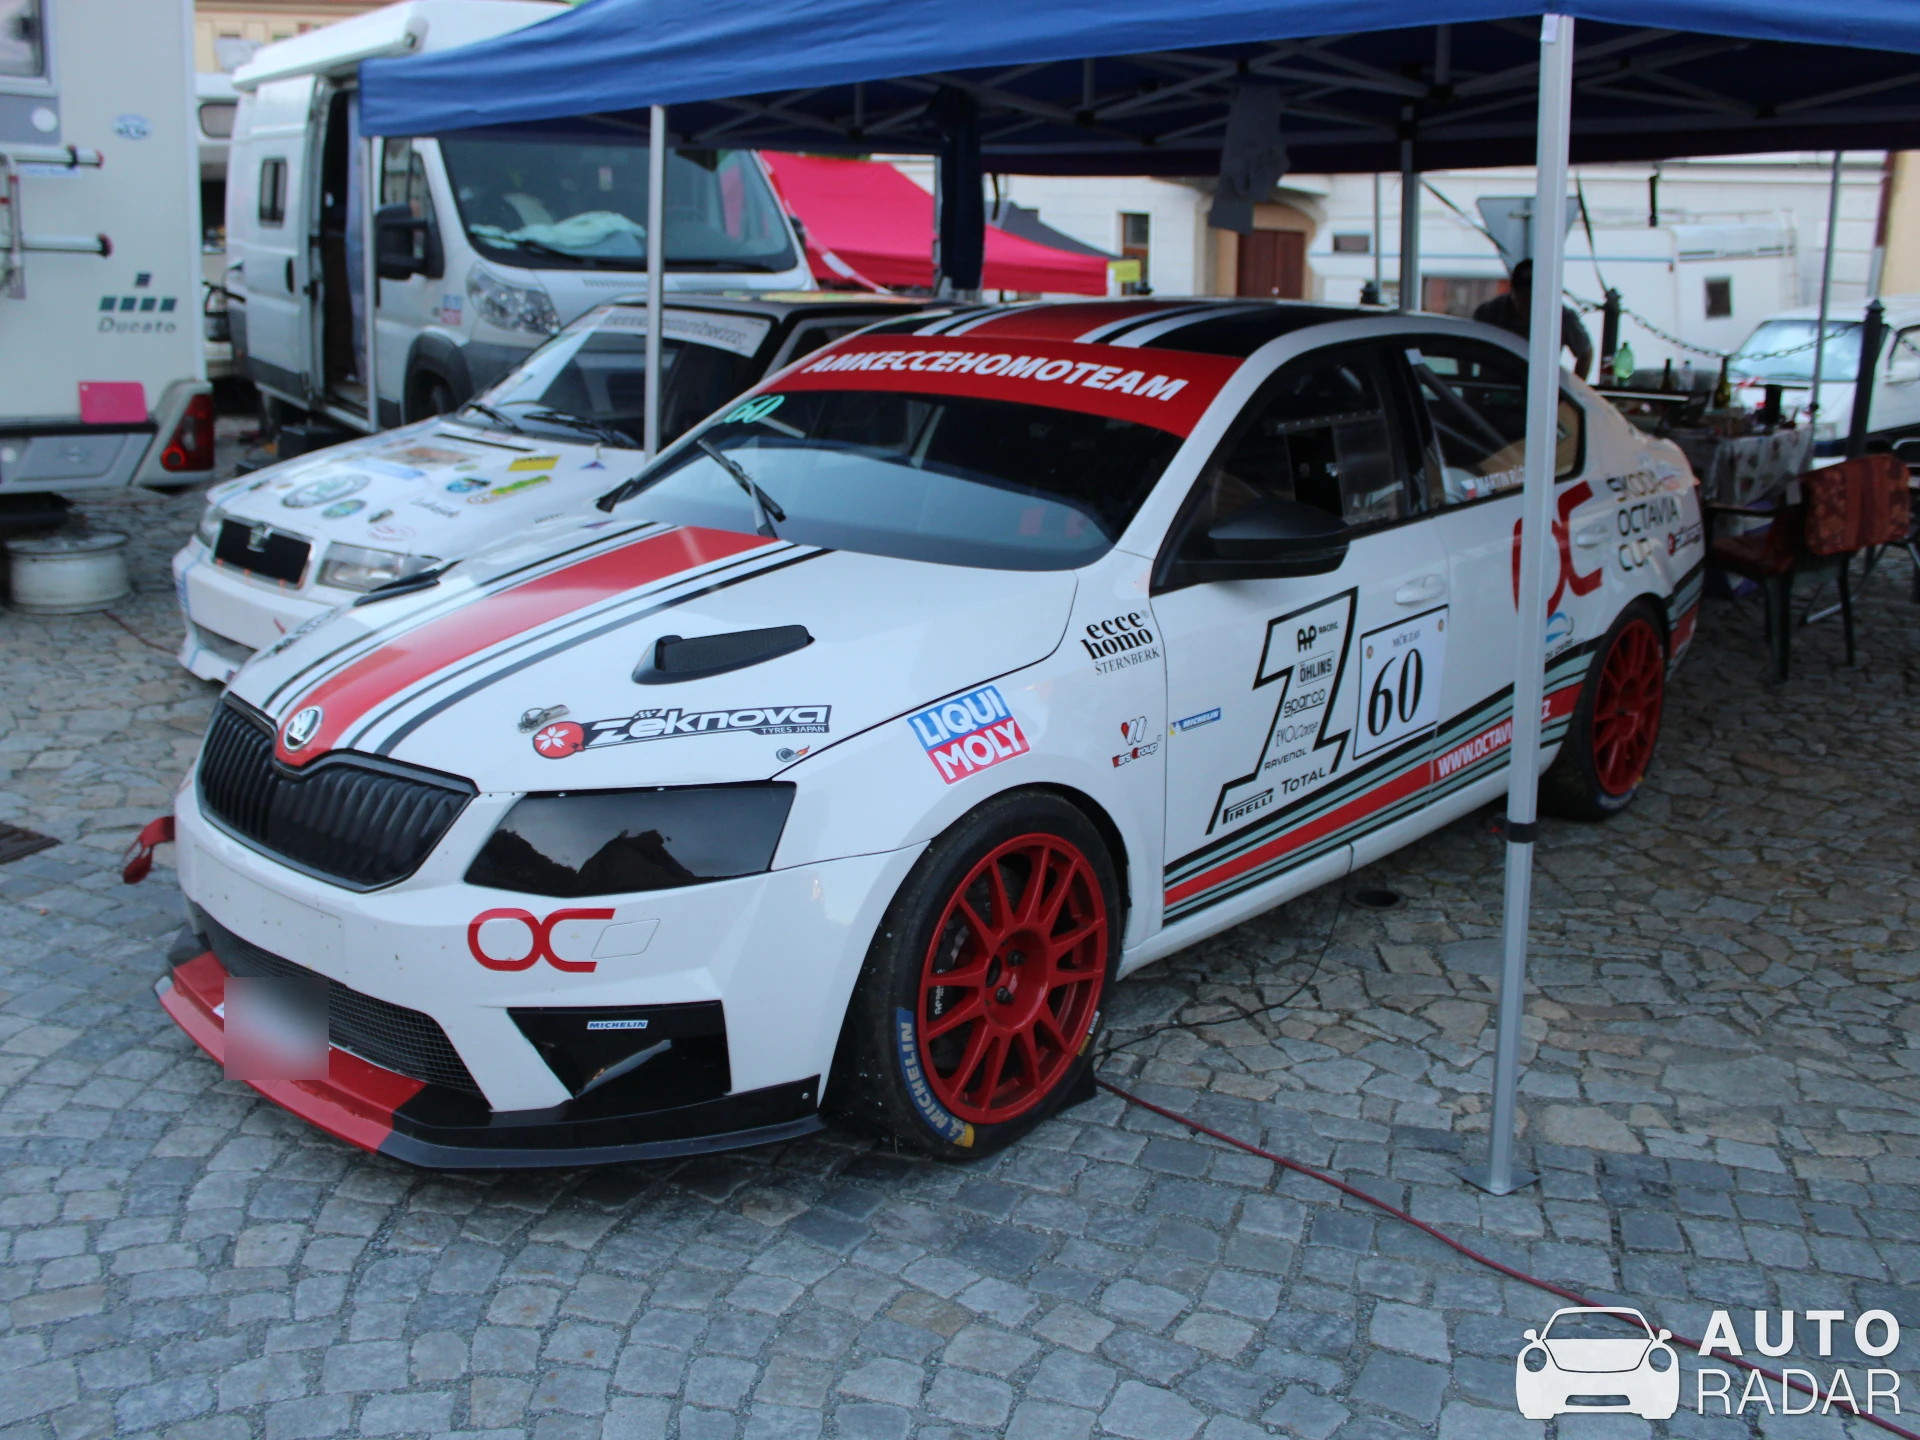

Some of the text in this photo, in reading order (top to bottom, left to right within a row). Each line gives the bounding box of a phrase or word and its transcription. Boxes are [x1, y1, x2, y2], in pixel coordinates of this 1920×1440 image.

[801, 351, 1189, 401] AMKECCEHOMOTEAM
[724, 395, 775, 424] 60
[1086, 612, 1144, 639] ecce
[1080, 628, 1154, 660] homo
[1095, 647, 1160, 676] ŠTERNBERK
[1300, 657, 1332, 682] ÖHLINS
[1284, 688, 1326, 718] sparco
[1368, 648, 1423, 736] 60
[761, 725, 826, 735] TYRES JAPAN
[912, 689, 1007, 747] LIQUI
[1182, 710, 1220, 729] MICHELIN
[933, 720, 1022, 780] MOLY
[1264, 748, 1307, 771] RAVENOL
[1282, 767, 1326, 795] TOTAL
[1222, 788, 1274, 825] PIRELLI
[588, 1020, 647, 1030] MICHELIN
[899, 1021, 949, 1131] MICHELIN
